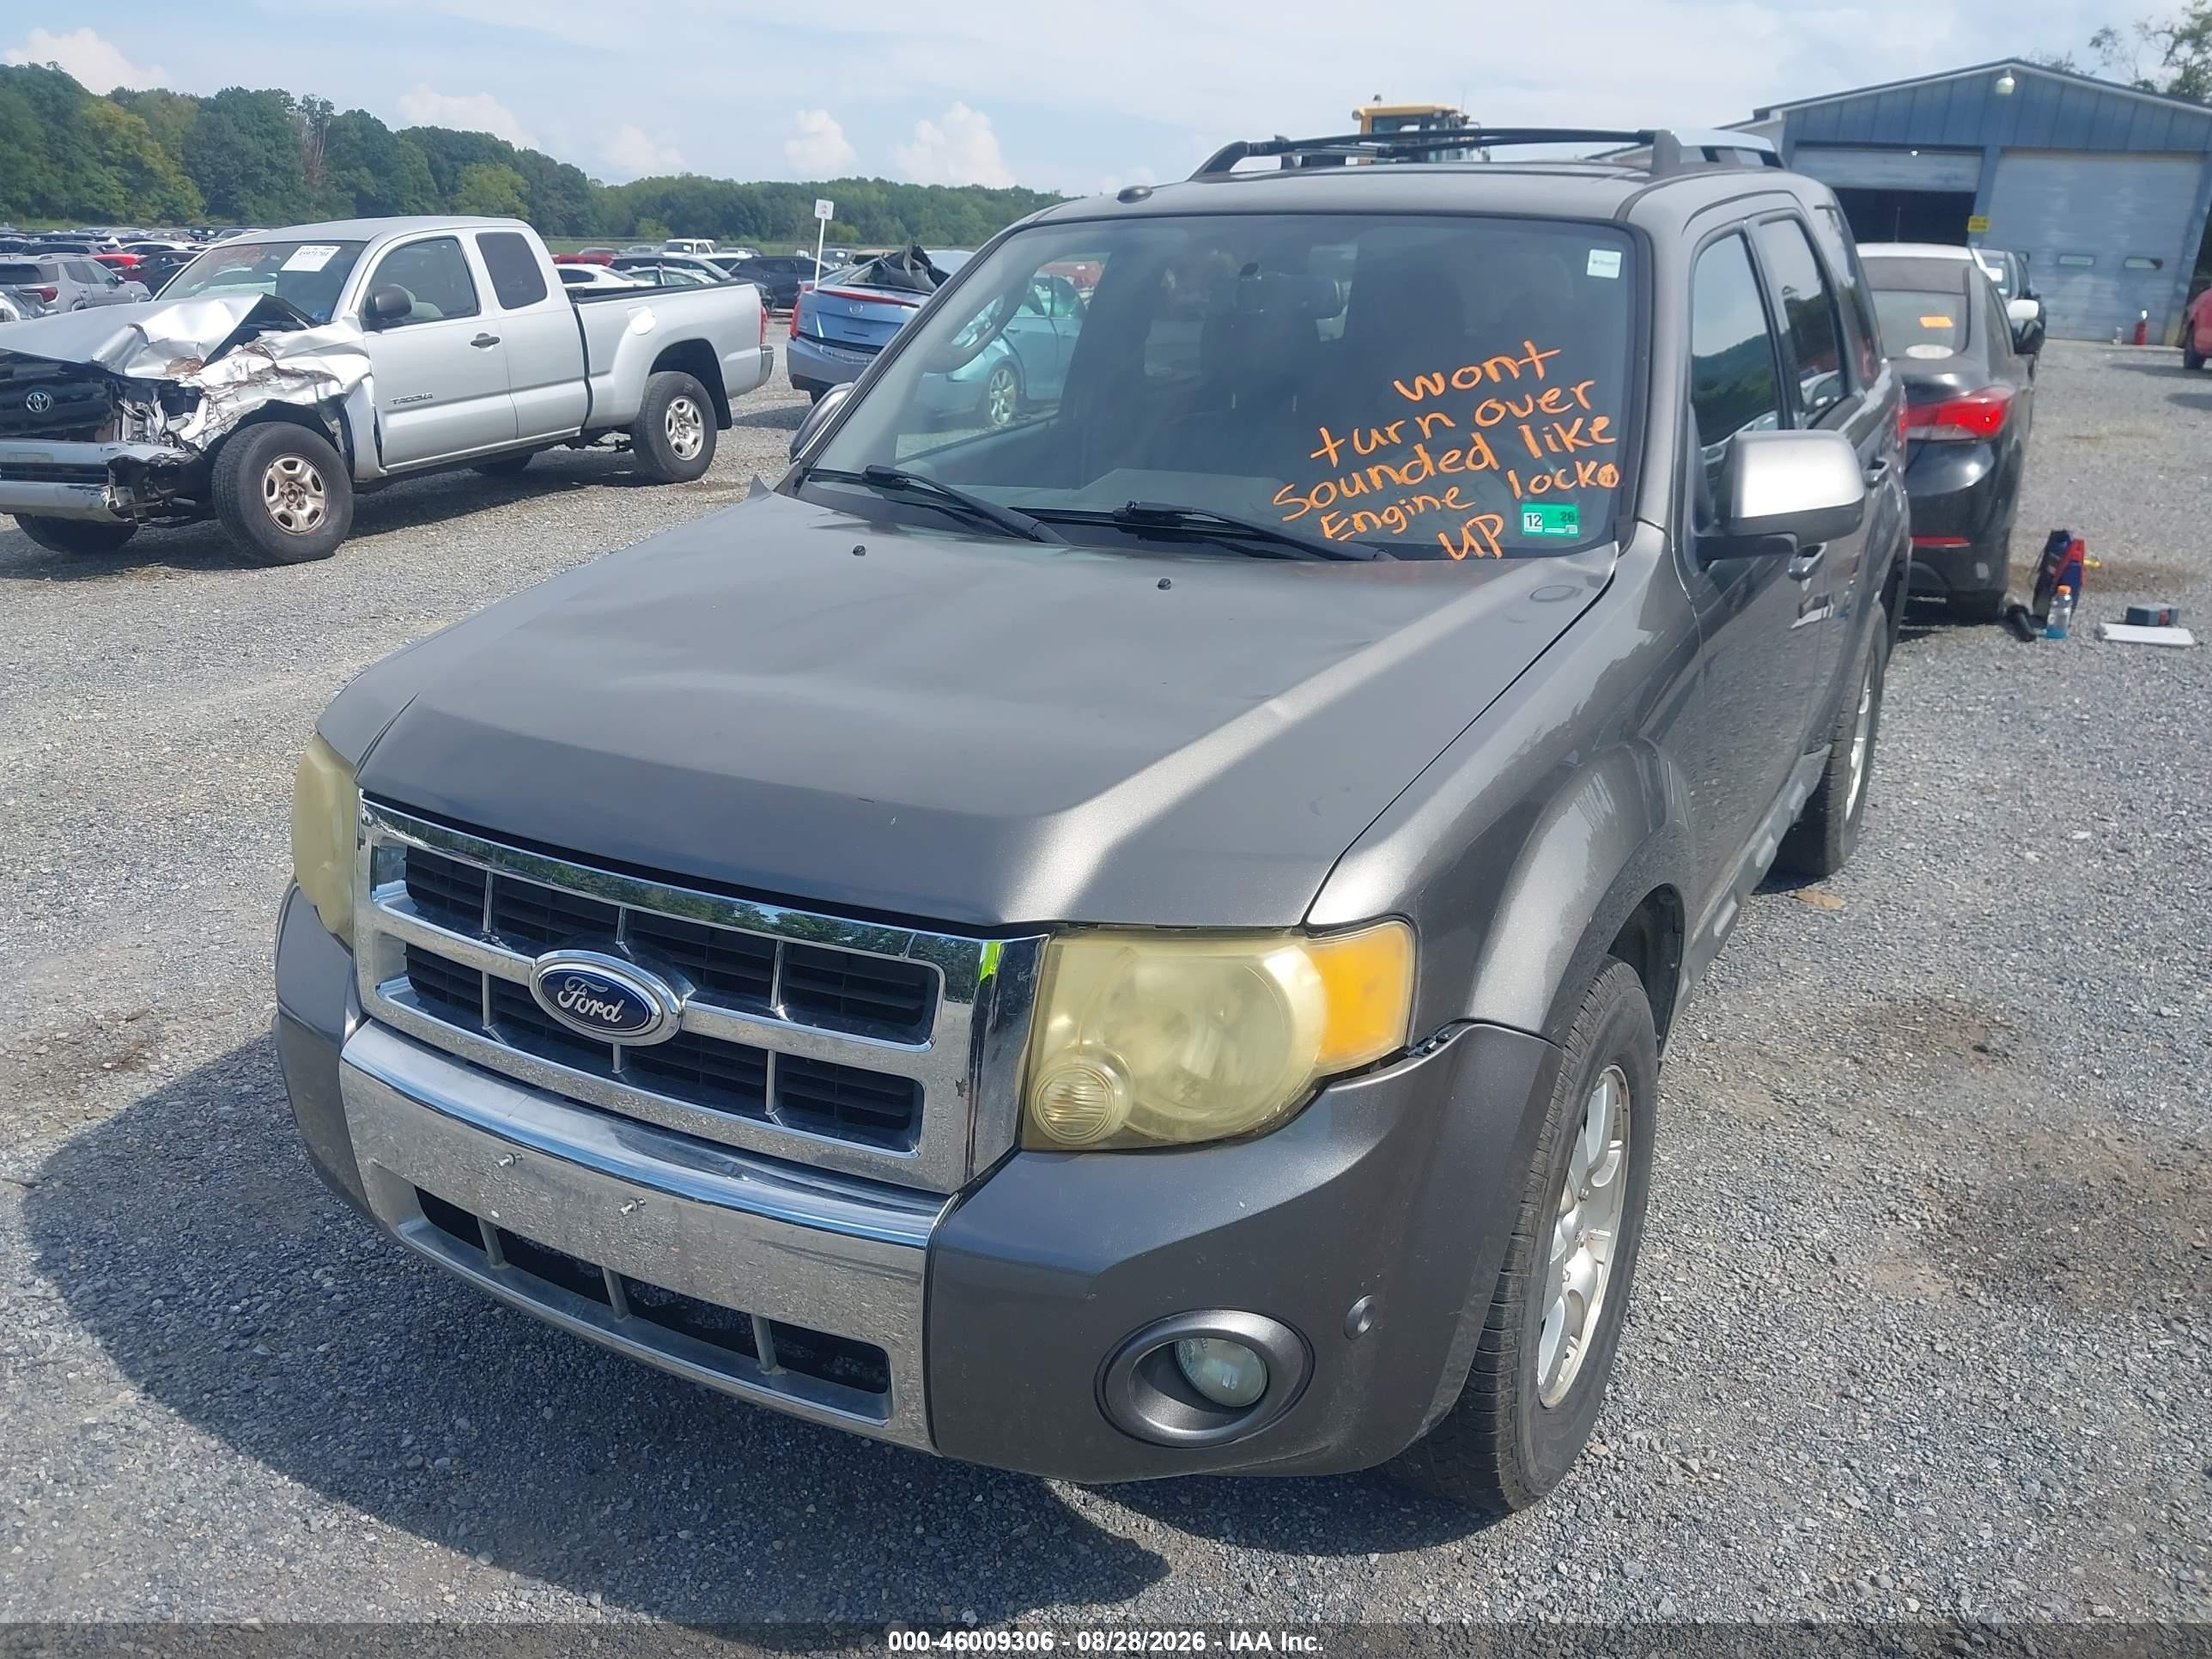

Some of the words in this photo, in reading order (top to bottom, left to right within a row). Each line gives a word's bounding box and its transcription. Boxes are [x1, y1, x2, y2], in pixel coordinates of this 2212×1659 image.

[1393, 340, 1560, 402] wont
[1310, 411, 1456, 468] turn
[1474, 380, 1595, 428] over
[1272, 431, 1501, 522] Sounded
[1518, 416, 1618, 459] like
[1319, 485, 1476, 541] Engine
[1437, 514, 1504, 561] UP
[1526, 514, 1542, 527] 12
[557, 975, 625, 1023] Ford
